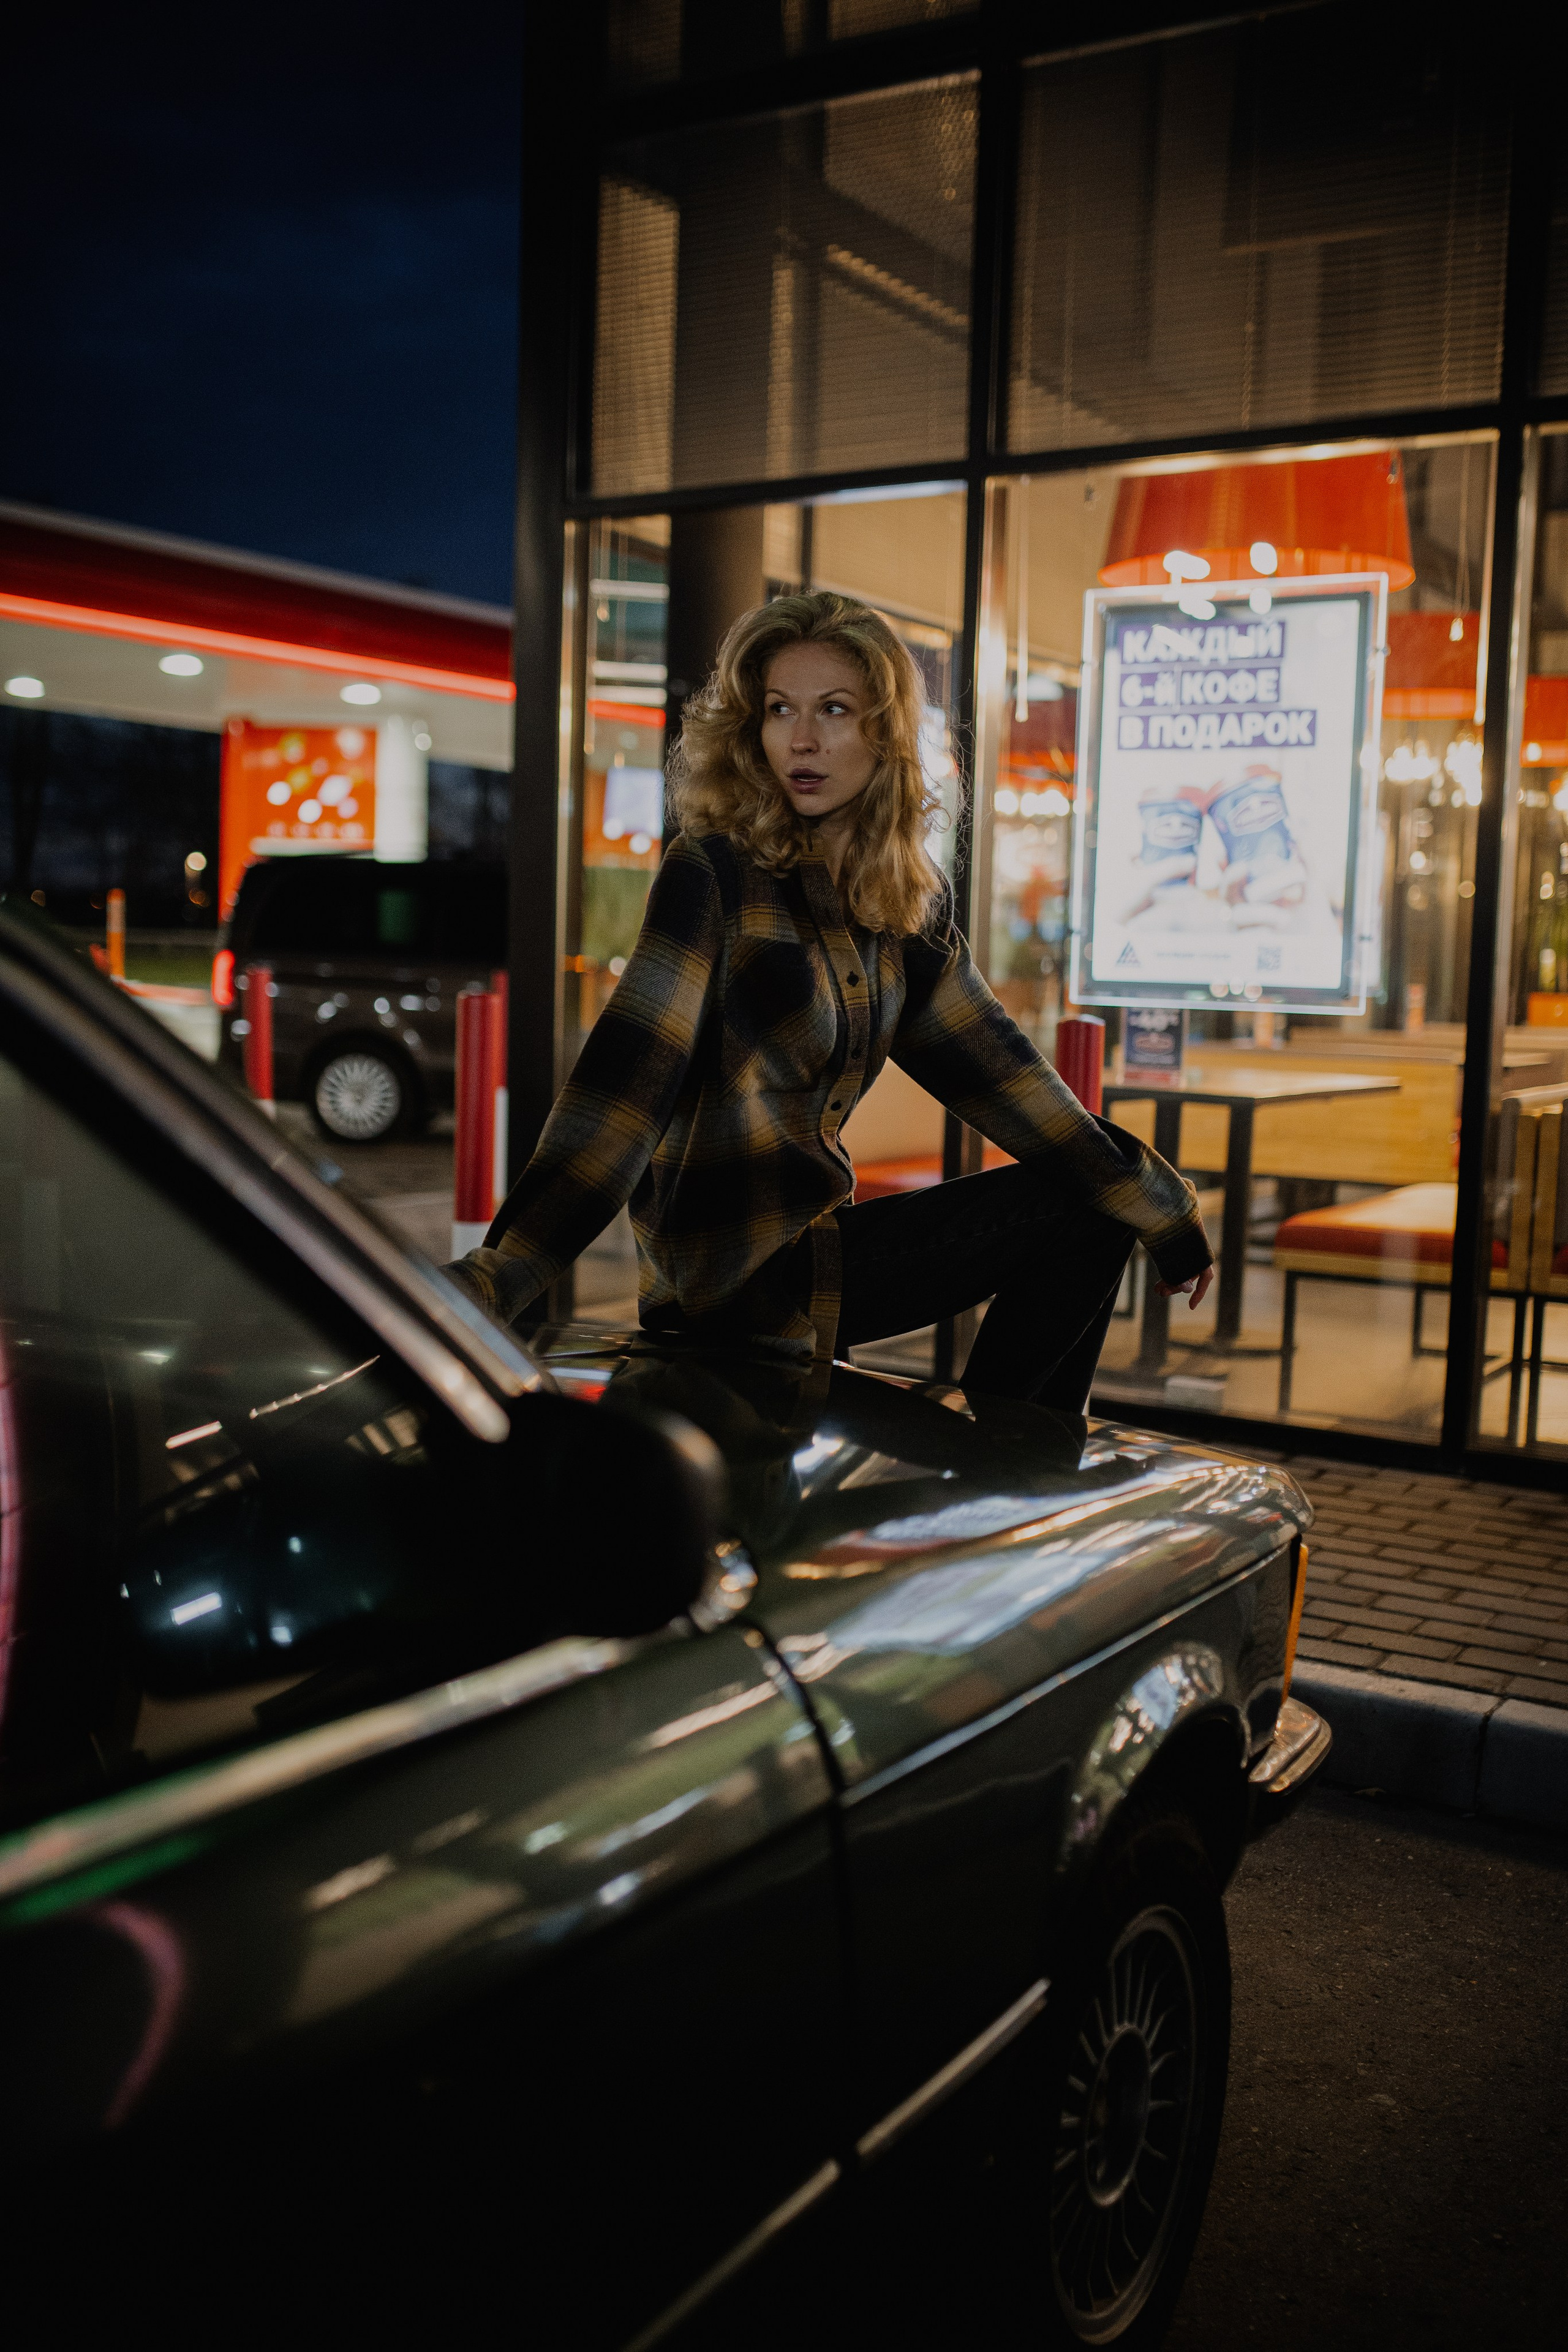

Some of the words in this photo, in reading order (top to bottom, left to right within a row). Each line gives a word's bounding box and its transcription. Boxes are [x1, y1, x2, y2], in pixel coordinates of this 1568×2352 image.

[1182, 669, 1279, 704] КОФЕ
[1119, 716, 1144, 749] В
[1148, 711, 1313, 750] ПОДАРОК
